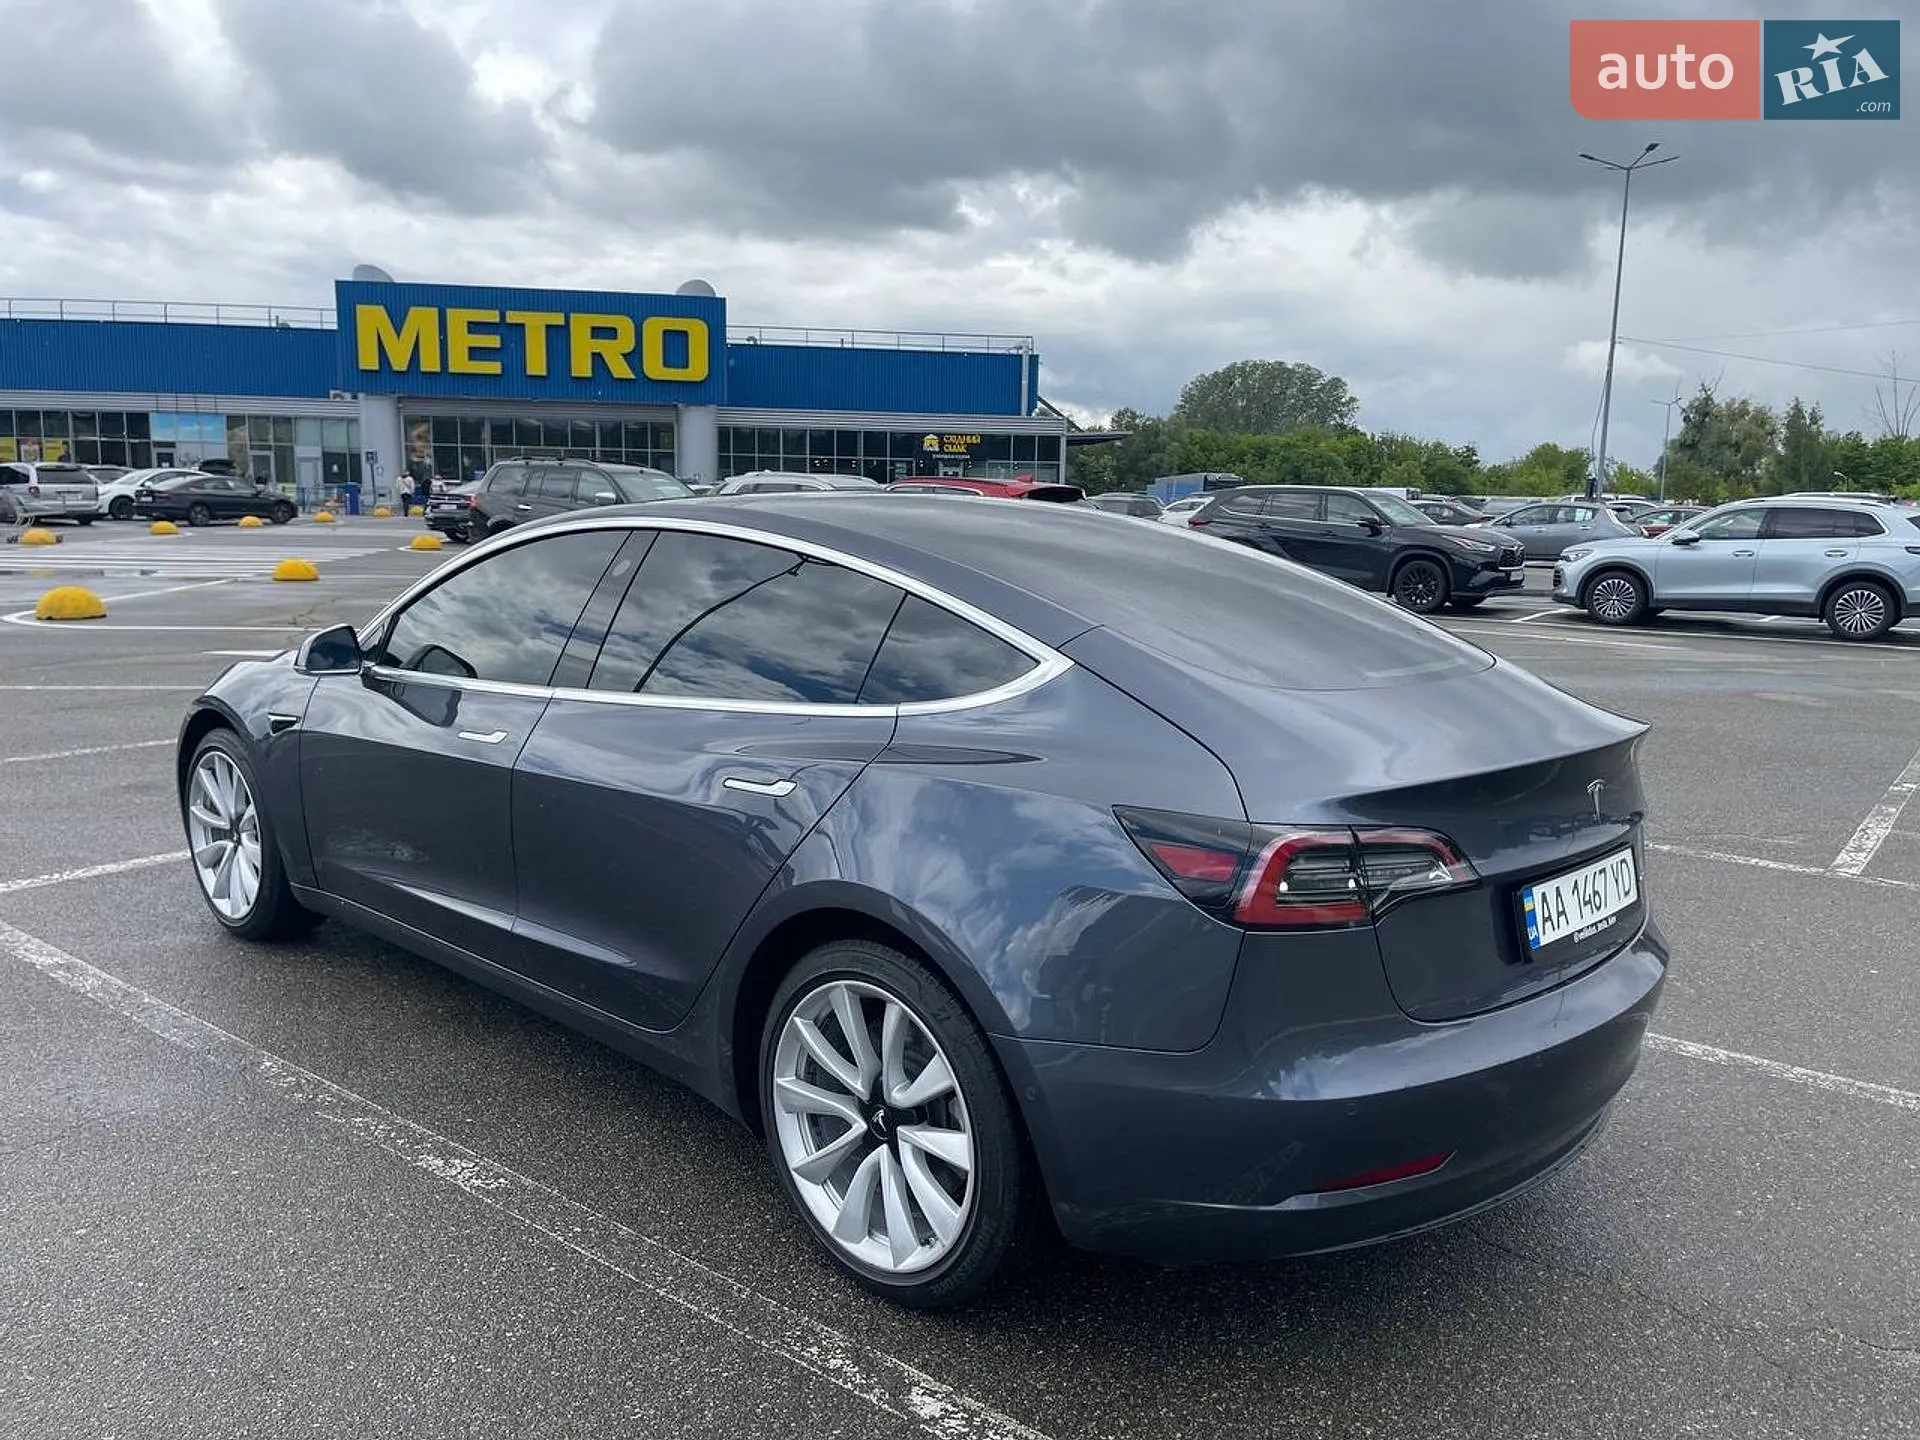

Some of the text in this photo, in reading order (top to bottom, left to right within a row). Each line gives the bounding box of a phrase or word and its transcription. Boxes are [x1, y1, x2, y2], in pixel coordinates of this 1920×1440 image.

[356, 304, 710, 382] METRO
[1540, 886, 1569, 936] AA
[1571, 867, 1608, 920] 1467
[1610, 858, 1632, 902] YD
